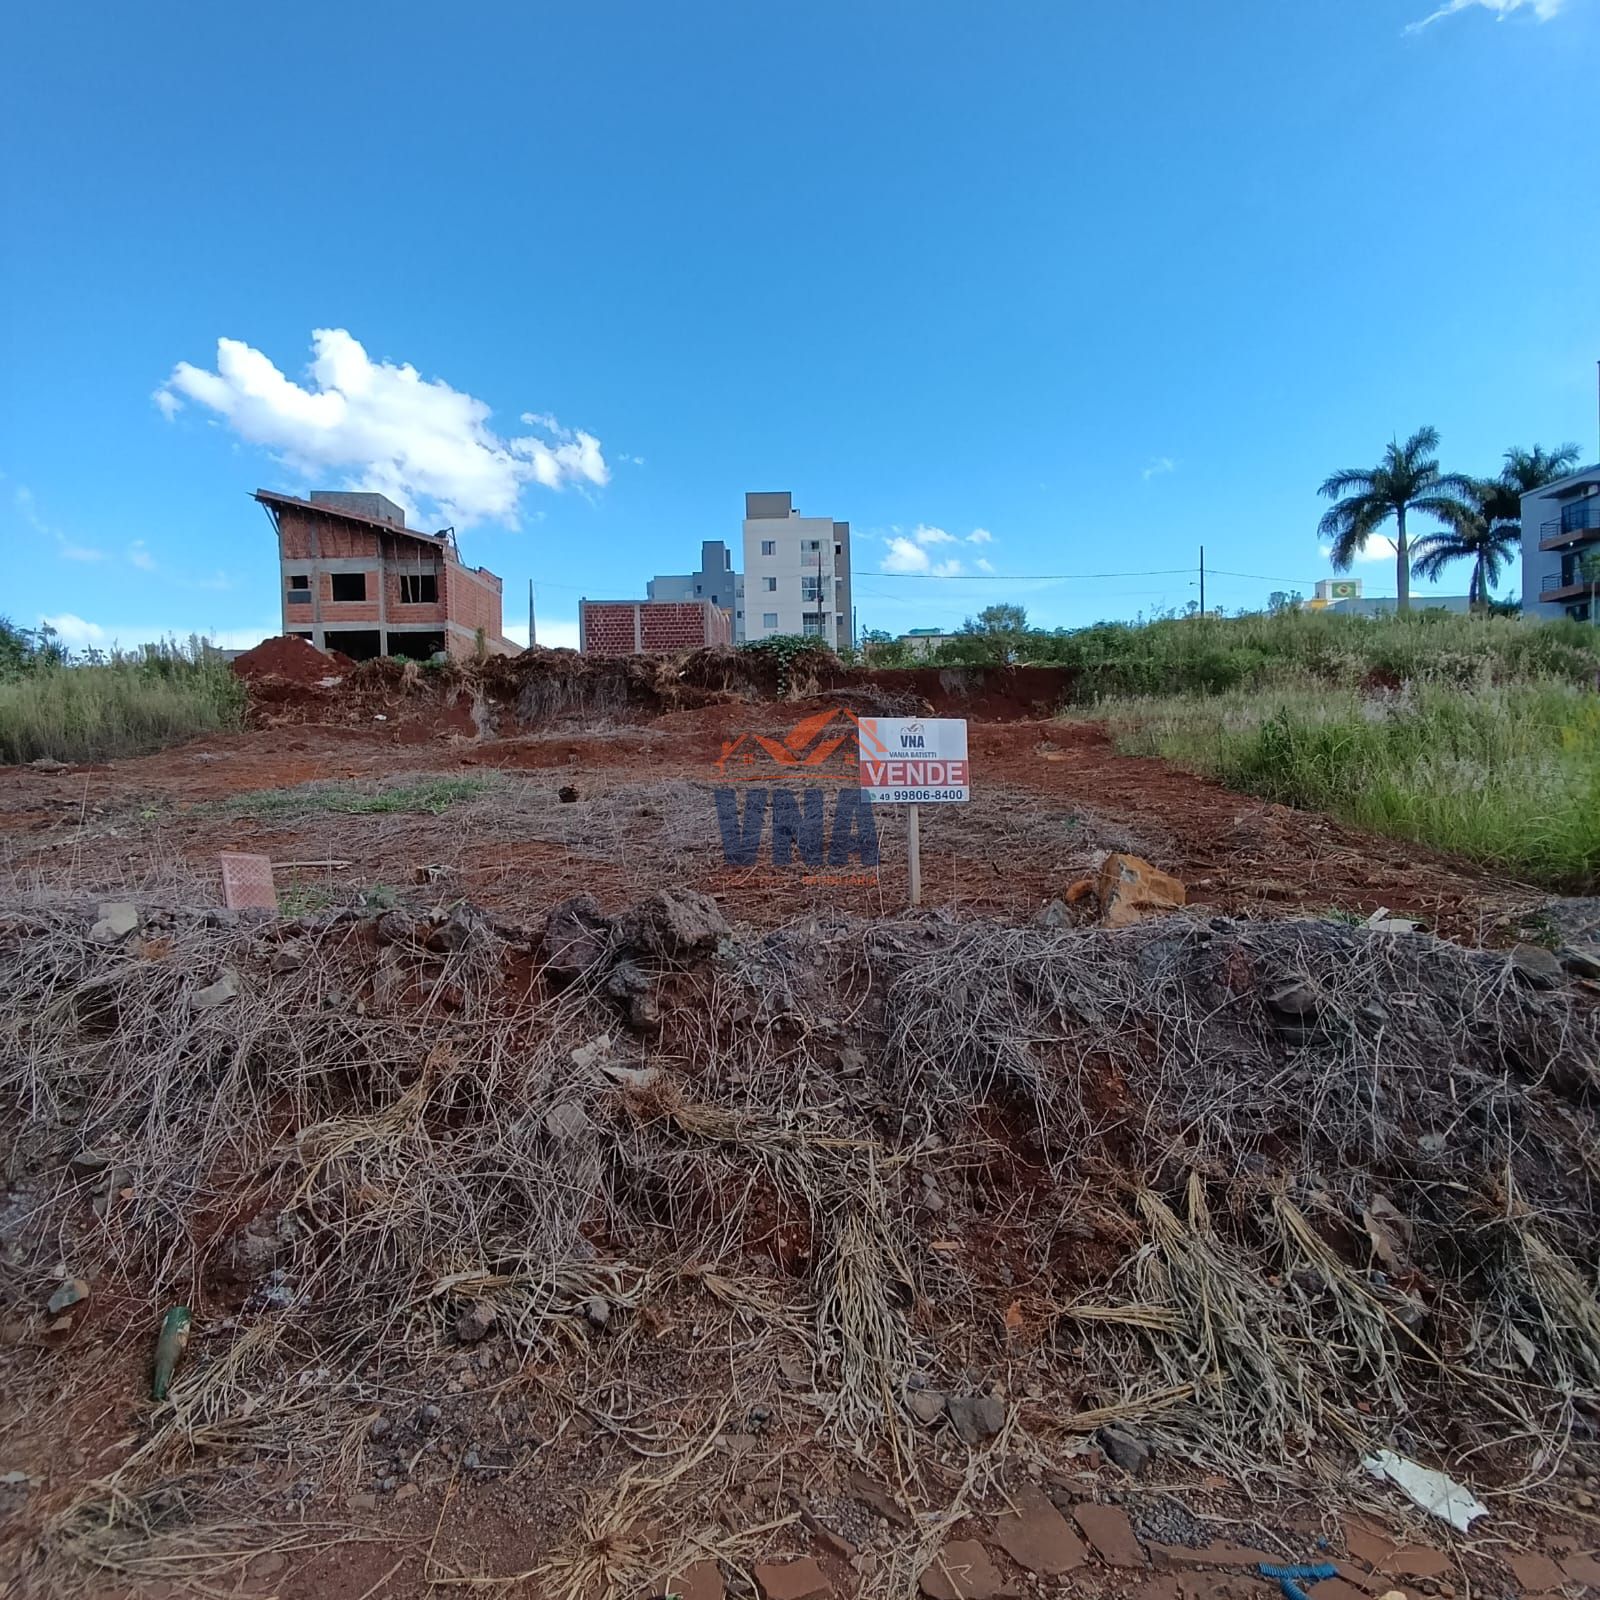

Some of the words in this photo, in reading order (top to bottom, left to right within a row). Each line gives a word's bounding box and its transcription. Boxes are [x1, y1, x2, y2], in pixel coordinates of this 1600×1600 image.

[900, 735, 925, 748] VNA
[866, 762, 964, 786] VENDE
[879, 793, 890, 801] 49
[894, 790, 963, 800] 99806-8400
